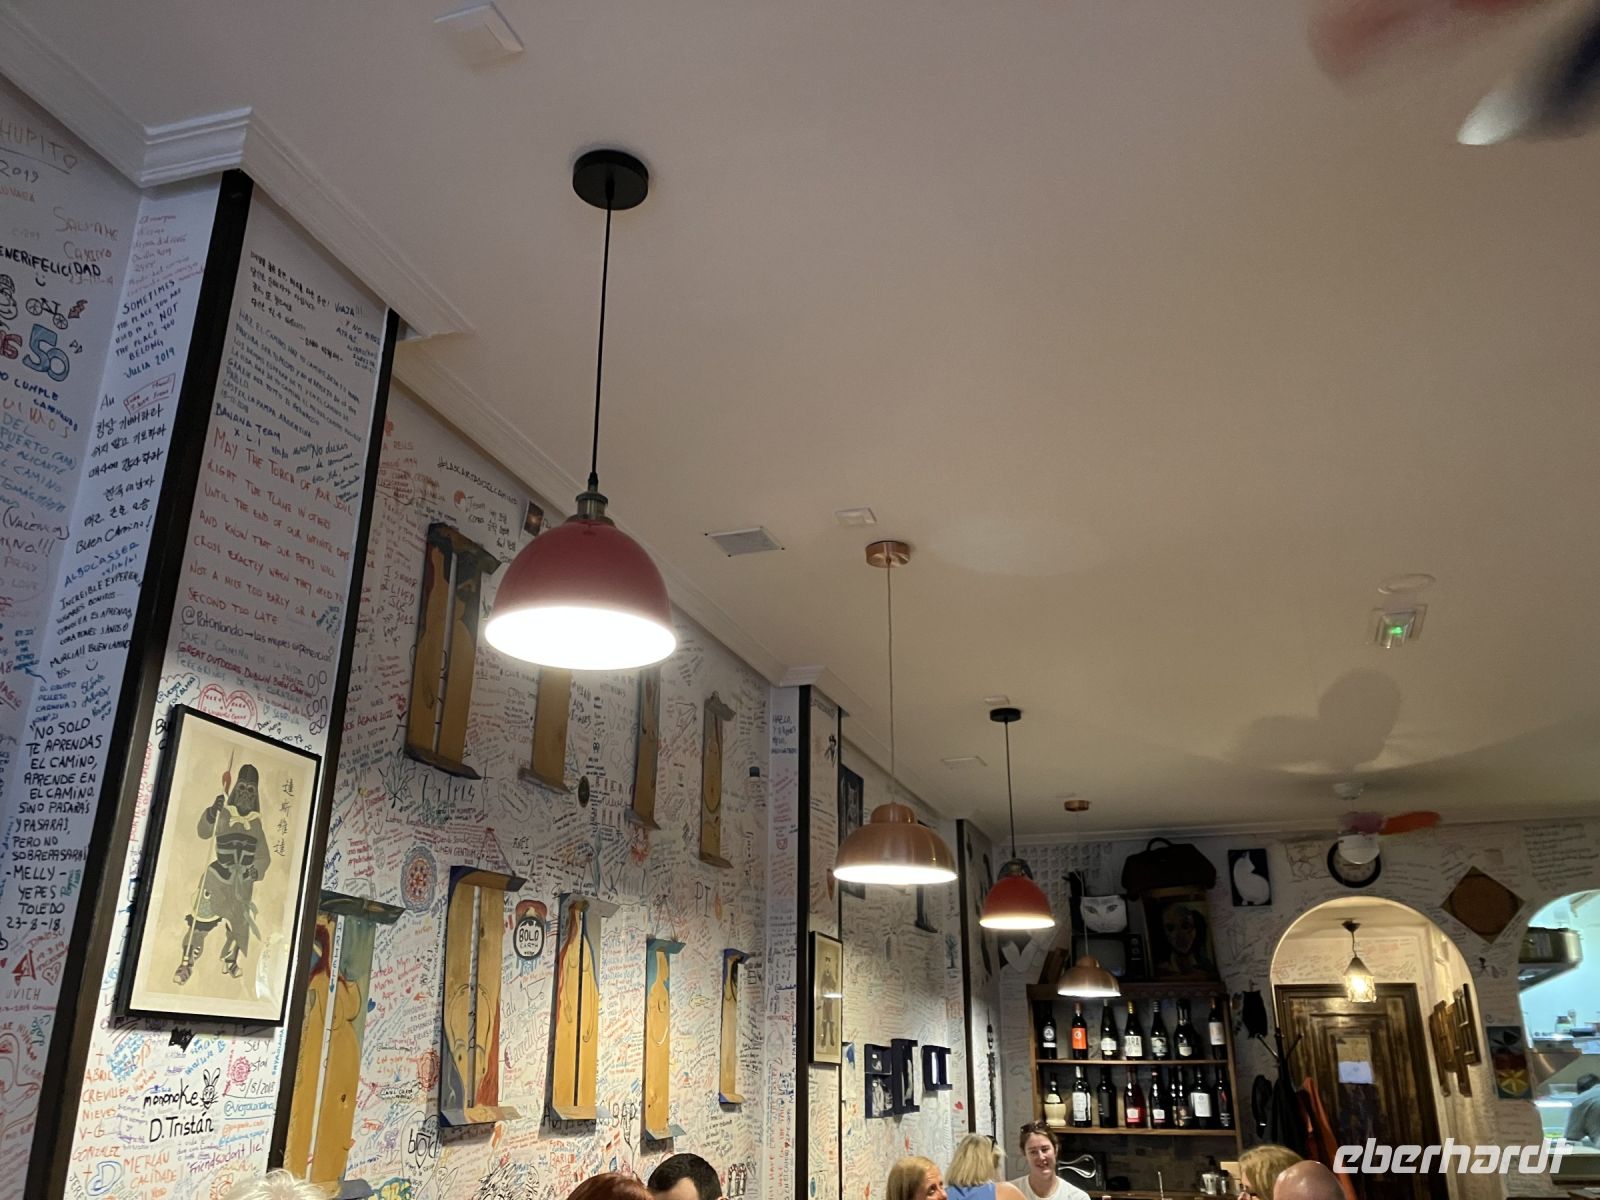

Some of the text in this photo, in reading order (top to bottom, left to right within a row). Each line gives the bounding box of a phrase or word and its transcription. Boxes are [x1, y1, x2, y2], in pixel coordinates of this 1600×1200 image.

[122, 280, 175, 315] SOMETIMES
[131, 308, 152, 324] PLACE
[159, 302, 178, 322] NOT
[133, 328, 157, 347] PLACE
[161, 319, 175, 331] YOU
[129, 339, 164, 360] BELONG
[123, 347, 175, 378] JULIA 2019
[216, 402, 281, 442] BANANA TEAM
[213, 426, 238, 461] MAY
[245, 447, 264, 469] THE
[300, 480, 311, 491] OF
[13, 466, 62, 493] CAMINO
[204, 481, 230, 503] UNTIL
[233, 496, 249, 513] THE
[252, 508, 269, 522] END
[200, 509, 218, 528] AND
[224, 521, 249, 540] KNOW
[76, 537, 102, 554] Buen
[189, 560, 317, 619] NOT A TOO EARLY OR A
[188, 586, 279, 624] SECOND TOO LATE
[178, 641, 206, 660] GREAT
[58, 717, 90, 735] SOLO
[25, 734, 103, 757] TE APRENDAS
[30, 757, 46, 770] EL
[23, 772, 96, 787] APRENDE EN
[29, 788, 43, 800] EL
[12, 835, 58, 848] PERO NO
[18, 885, 57, 900] YEPES
[18, 902, 65, 915] TOLEDO
[6, 916, 61, 931] 23-8-18
[519, 928, 539, 942] BOLD
[82, 1106, 117, 1122] NIEVES
